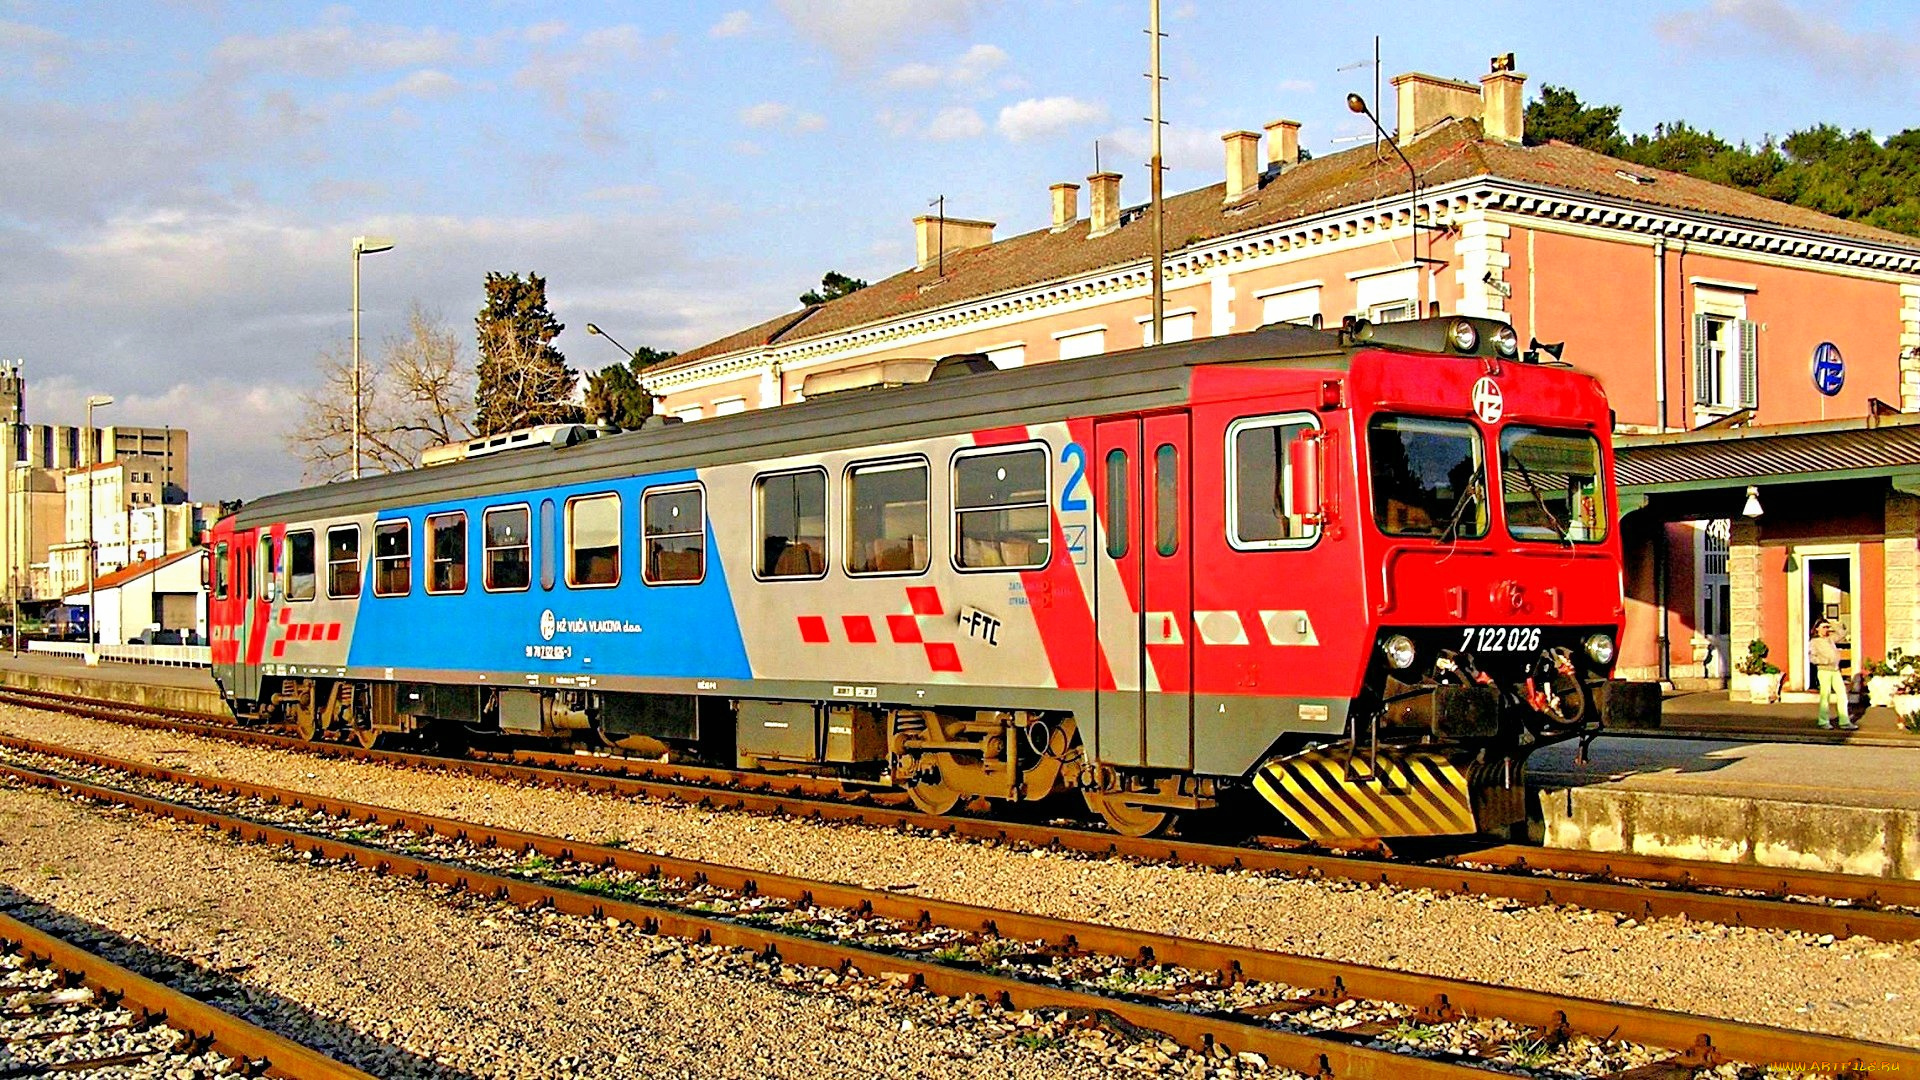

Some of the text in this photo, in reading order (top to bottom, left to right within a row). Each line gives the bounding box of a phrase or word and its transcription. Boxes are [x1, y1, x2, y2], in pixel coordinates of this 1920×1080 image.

[1060, 442, 1087, 511] 2
[589, 620, 622, 632] VLAKOVA
[1459, 627, 1541, 653] 7 122 026
